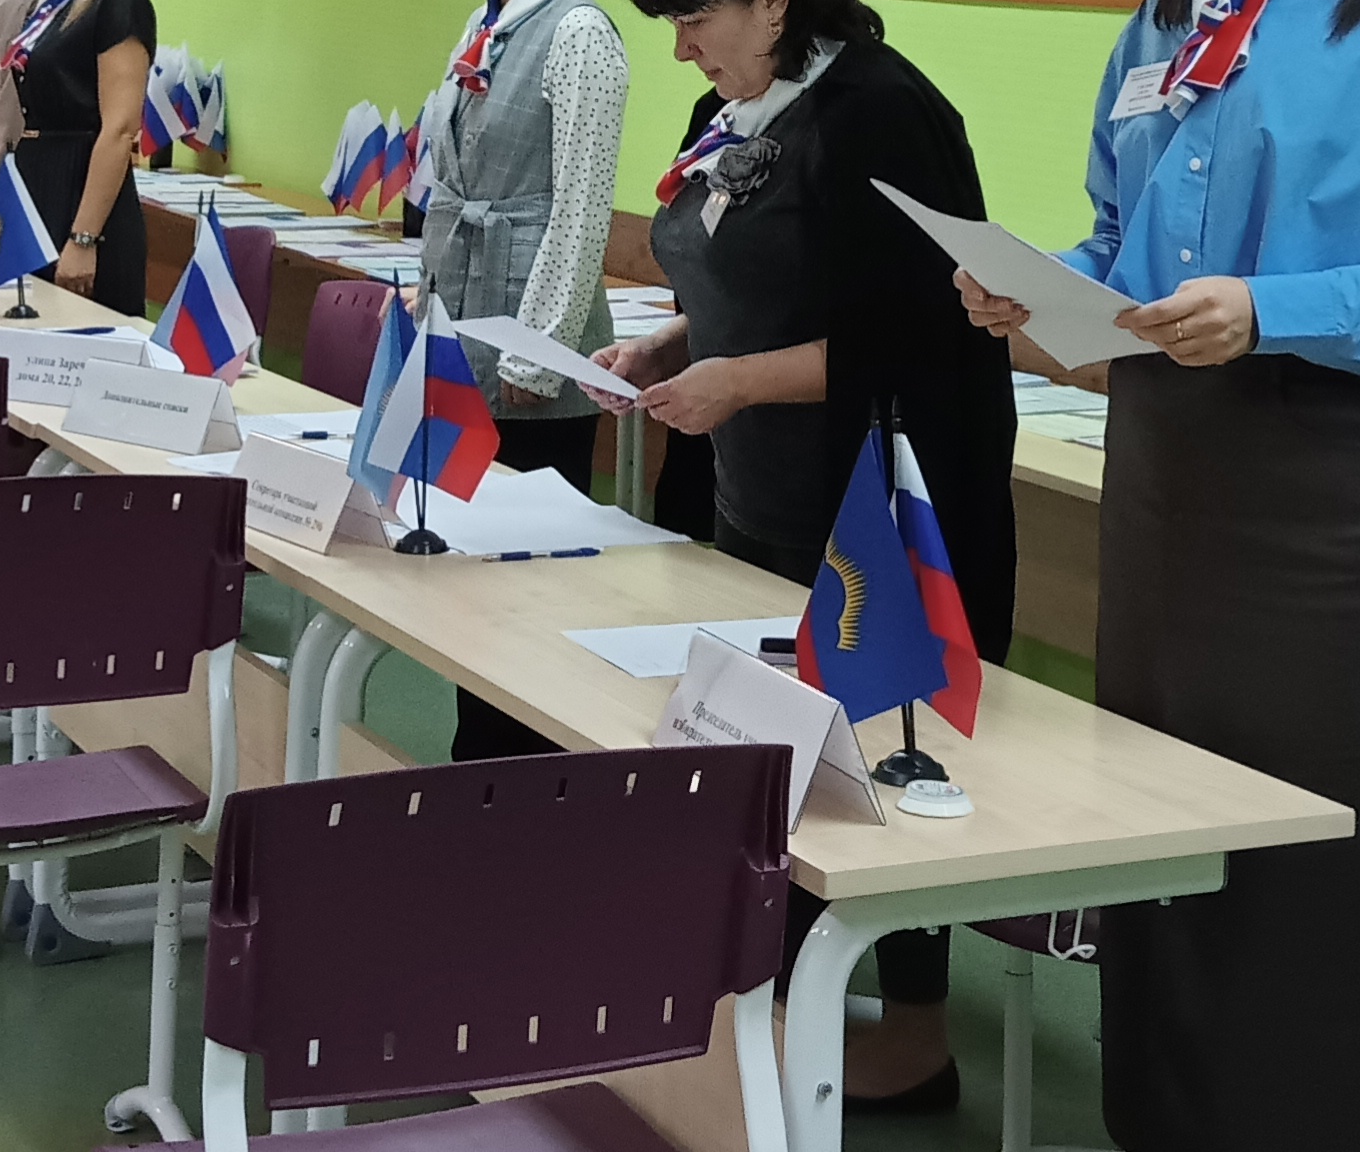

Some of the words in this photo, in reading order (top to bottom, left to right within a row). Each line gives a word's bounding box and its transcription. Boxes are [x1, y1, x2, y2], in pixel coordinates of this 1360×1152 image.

[26, 356, 56, 367] улица
[15, 373, 39, 383] дома
[42, 374, 56, 385] 20,
[58, 375, 72, 387] 22,
